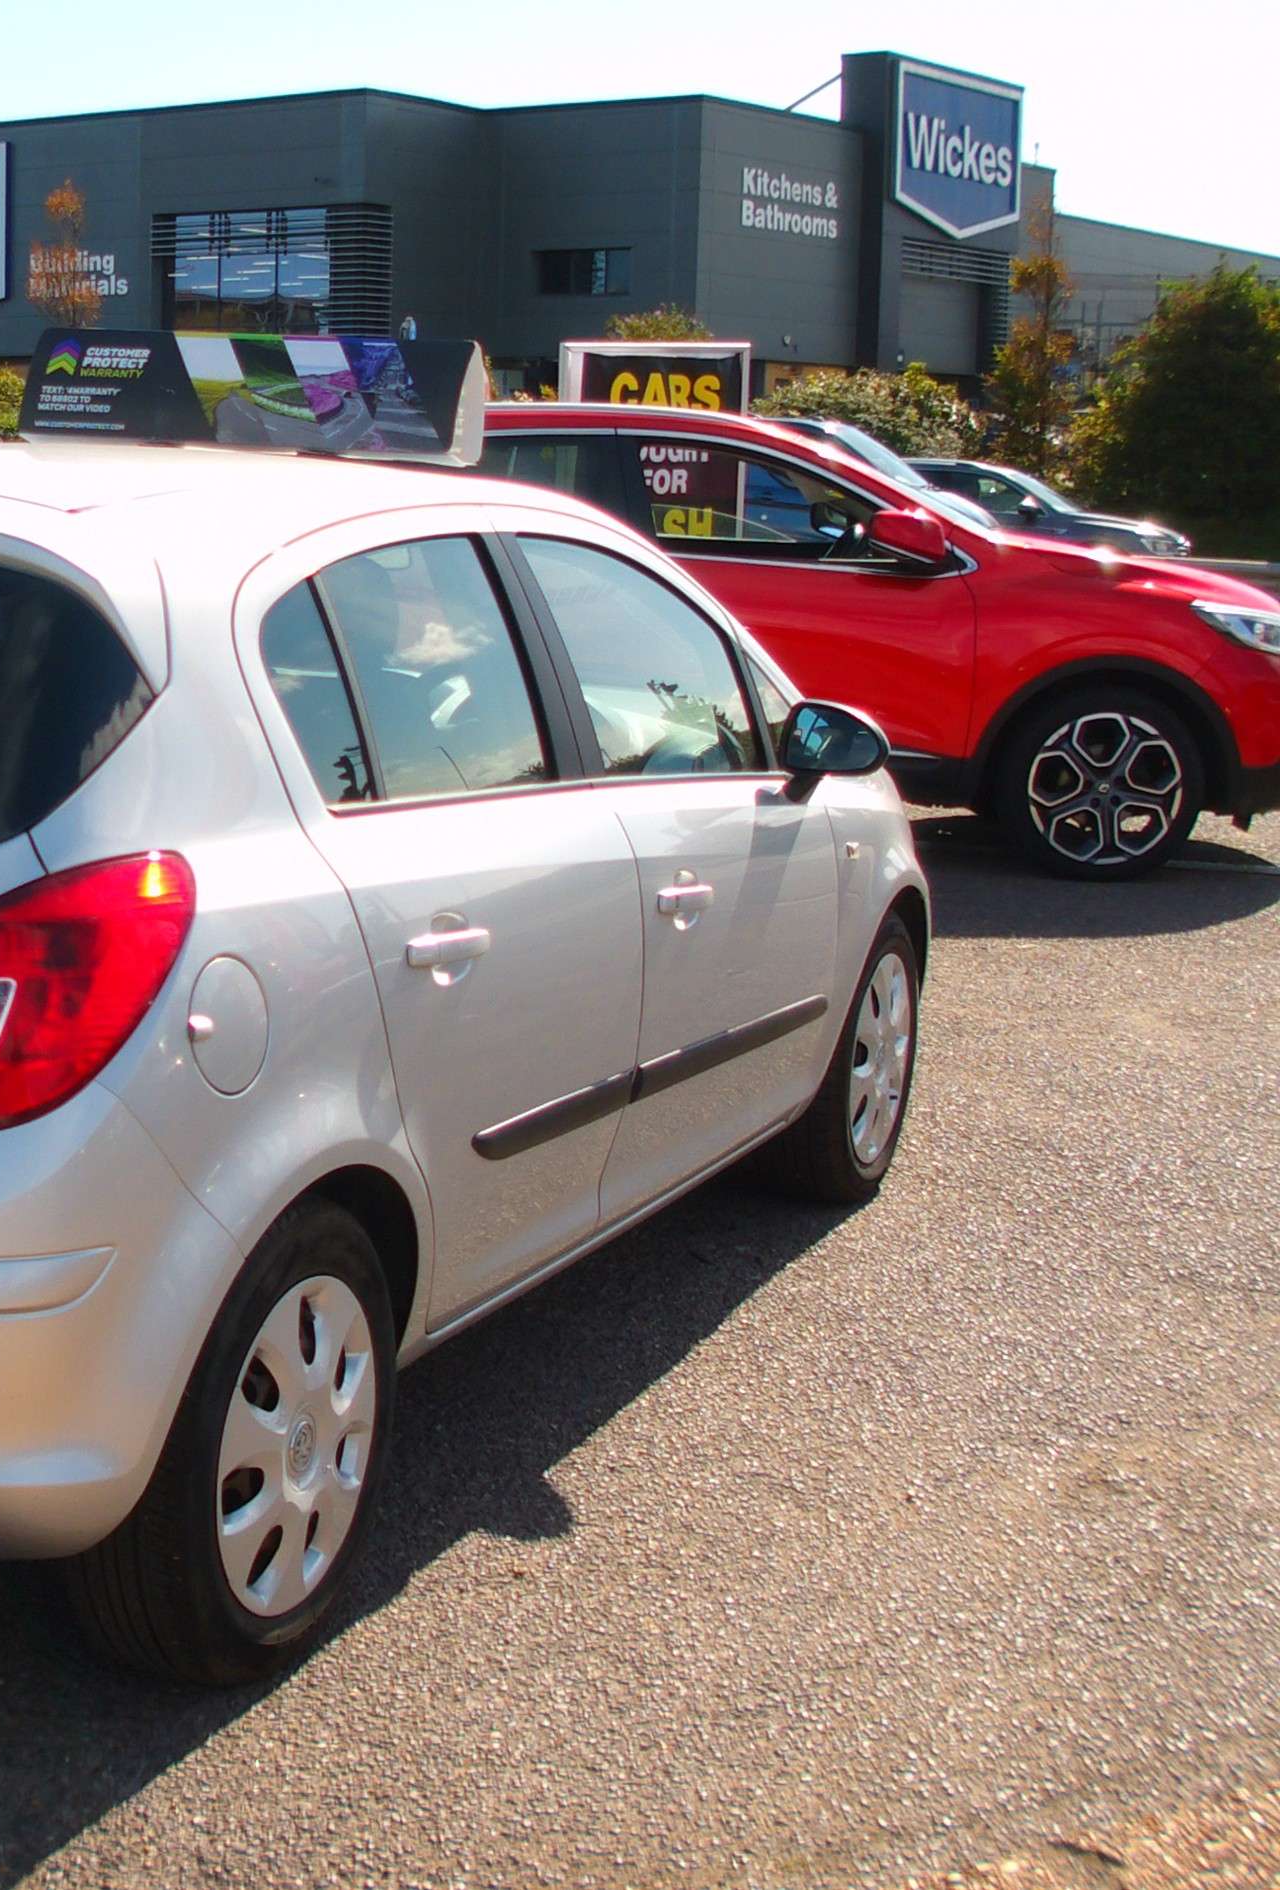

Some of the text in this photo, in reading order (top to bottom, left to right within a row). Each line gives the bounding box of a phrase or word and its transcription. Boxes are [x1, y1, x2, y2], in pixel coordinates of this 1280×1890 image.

[907, 112, 1012, 187] Wickes
[742, 167, 838, 208] Kitchens &
[741, 201, 838, 239] Bathrooms
[82, 357, 148, 369] PROTECT
[86, 347, 151, 358] CUSTOMER
[80, 368, 144, 378] WARRANTY
[610, 372, 720, 412] CARS
[663, 507, 713, 537] SH
